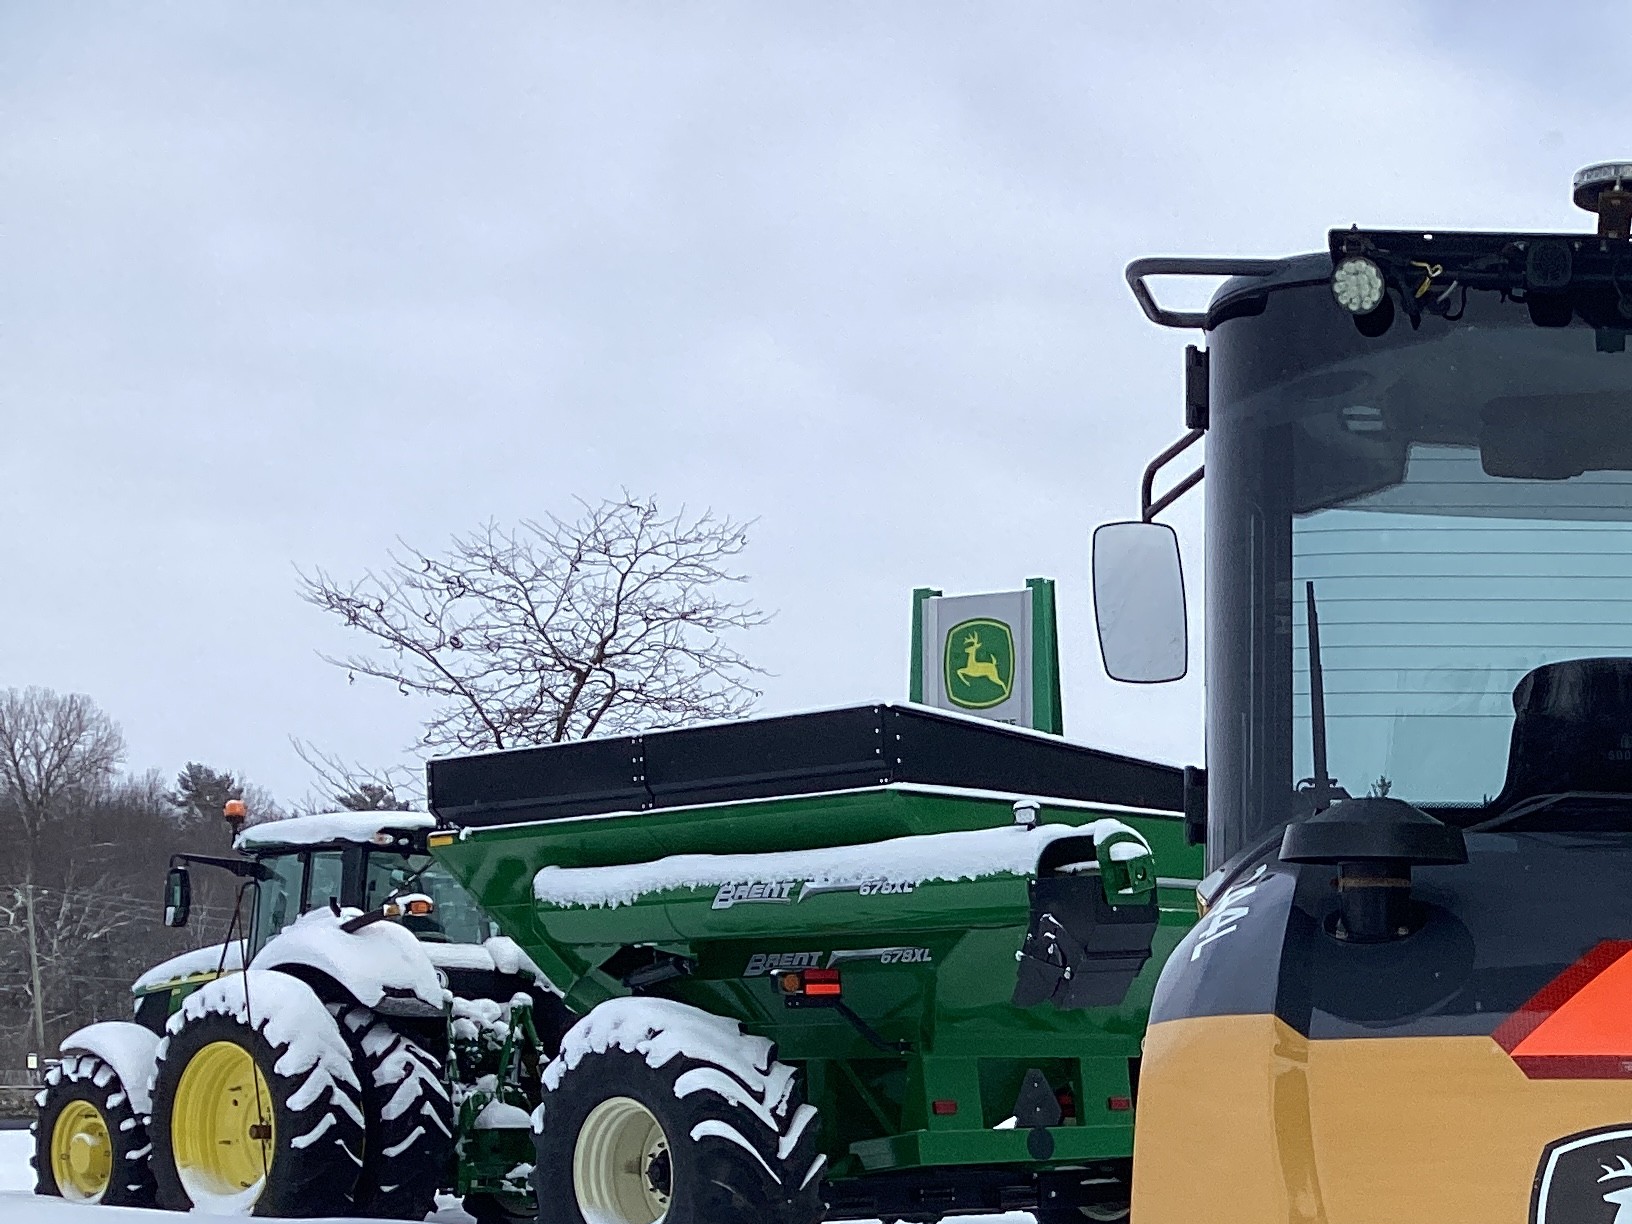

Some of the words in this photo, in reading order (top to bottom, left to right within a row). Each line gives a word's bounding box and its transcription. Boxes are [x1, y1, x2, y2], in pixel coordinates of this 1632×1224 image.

[711, 881, 796, 910] BRENT
[859, 880, 915, 896] 678XL
[743, 951, 824, 977] BRENT
[880, 948, 933, 964] 678XL
